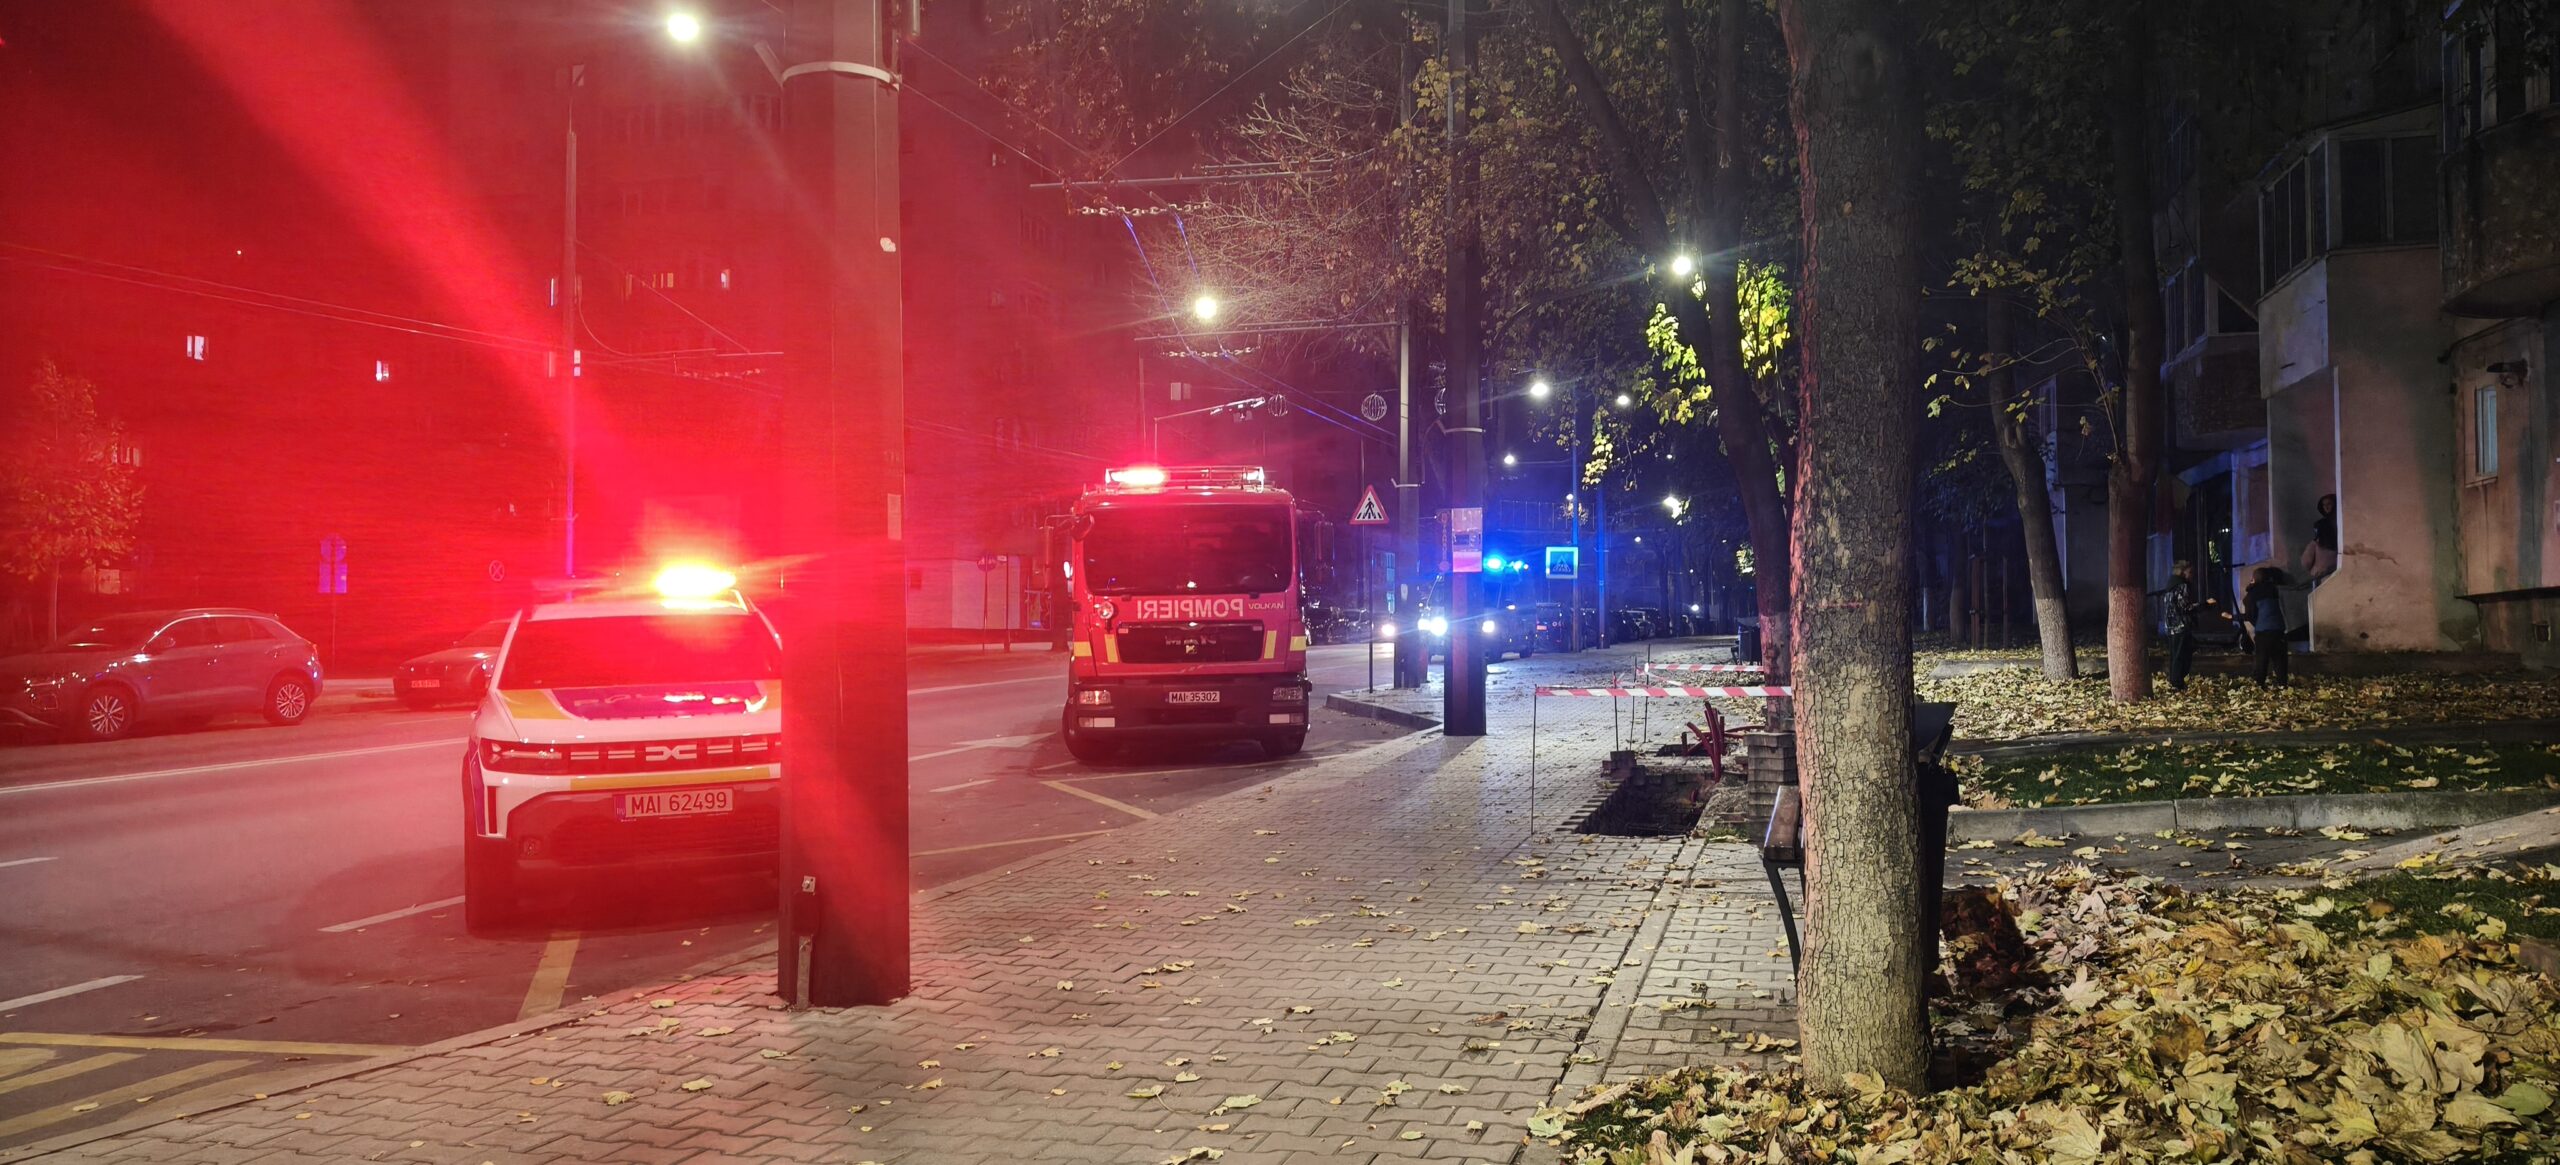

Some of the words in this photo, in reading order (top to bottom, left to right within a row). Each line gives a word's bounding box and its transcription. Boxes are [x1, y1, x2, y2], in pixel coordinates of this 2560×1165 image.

[1248, 601, 1284, 610] VOLKAN
[1171, 692, 1186, 702] MAI
[1190, 692, 1218, 702] 35302
[631, 795, 660, 815] MAI
[669, 792, 727, 812] 62499
